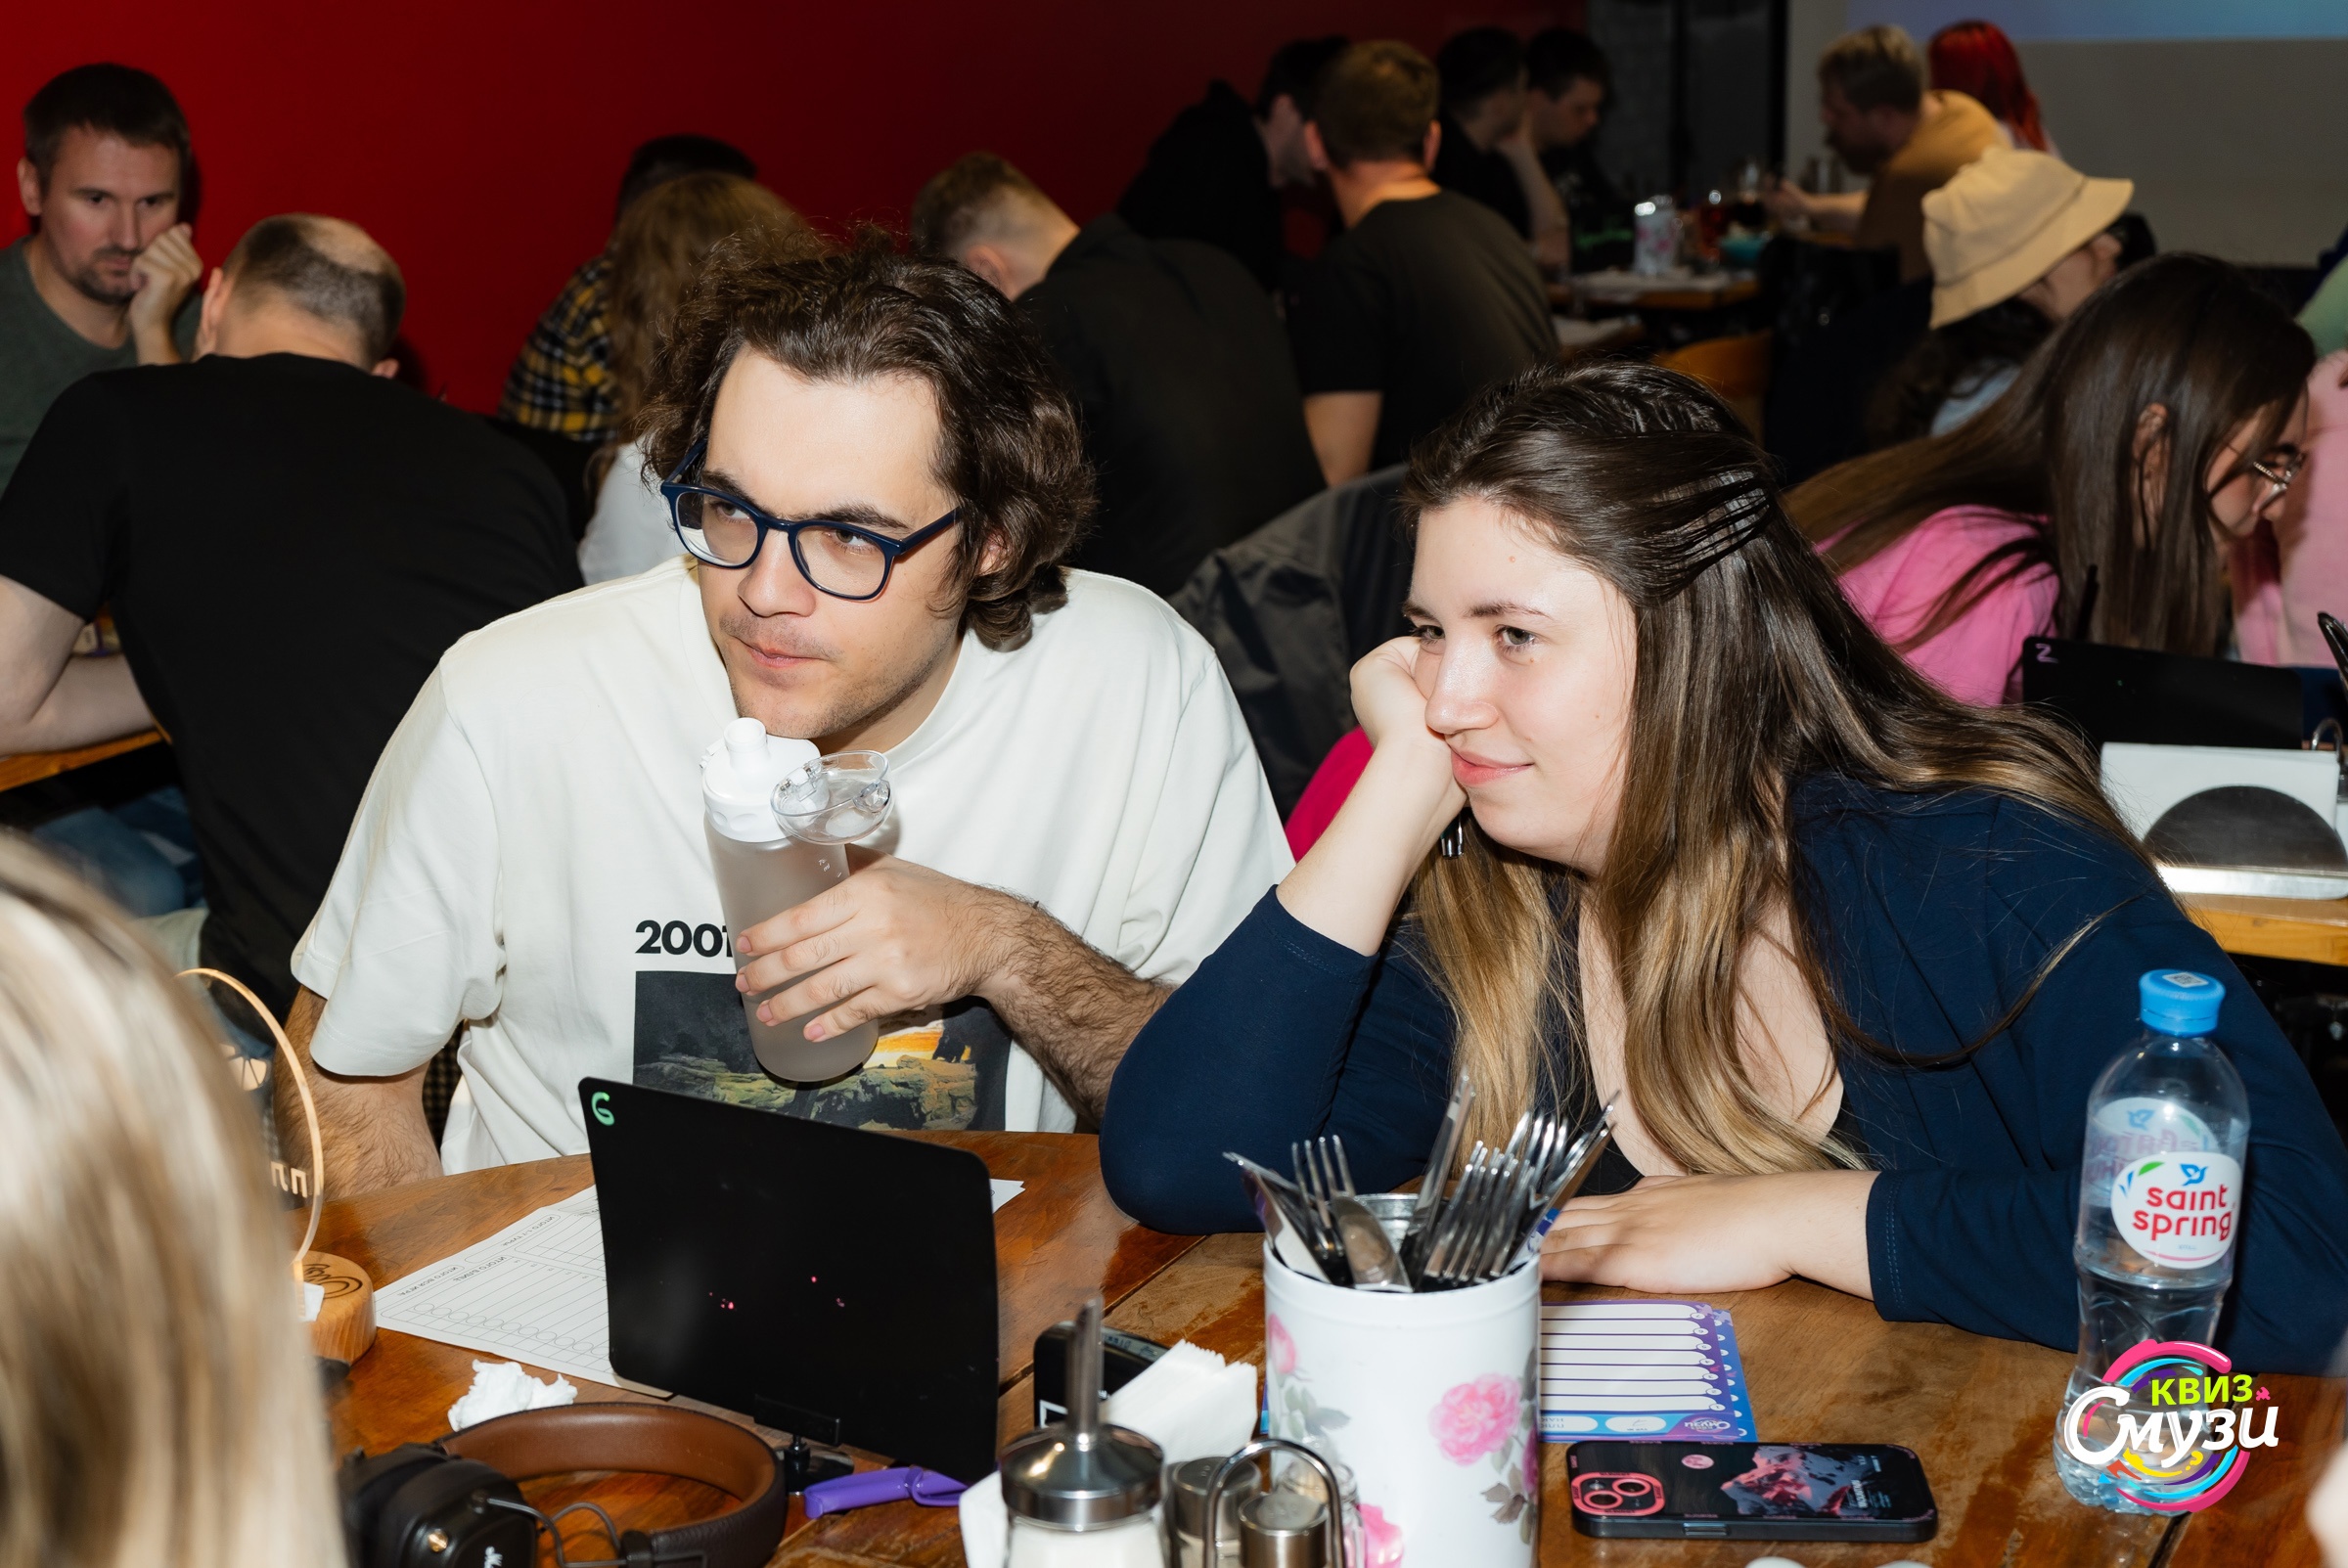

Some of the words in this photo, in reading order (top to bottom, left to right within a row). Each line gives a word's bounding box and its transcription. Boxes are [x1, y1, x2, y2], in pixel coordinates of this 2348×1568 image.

[635, 919, 734, 958] 2001
[2145, 1184, 2230, 1211] saint
[2132, 1209, 2233, 1242] spring
